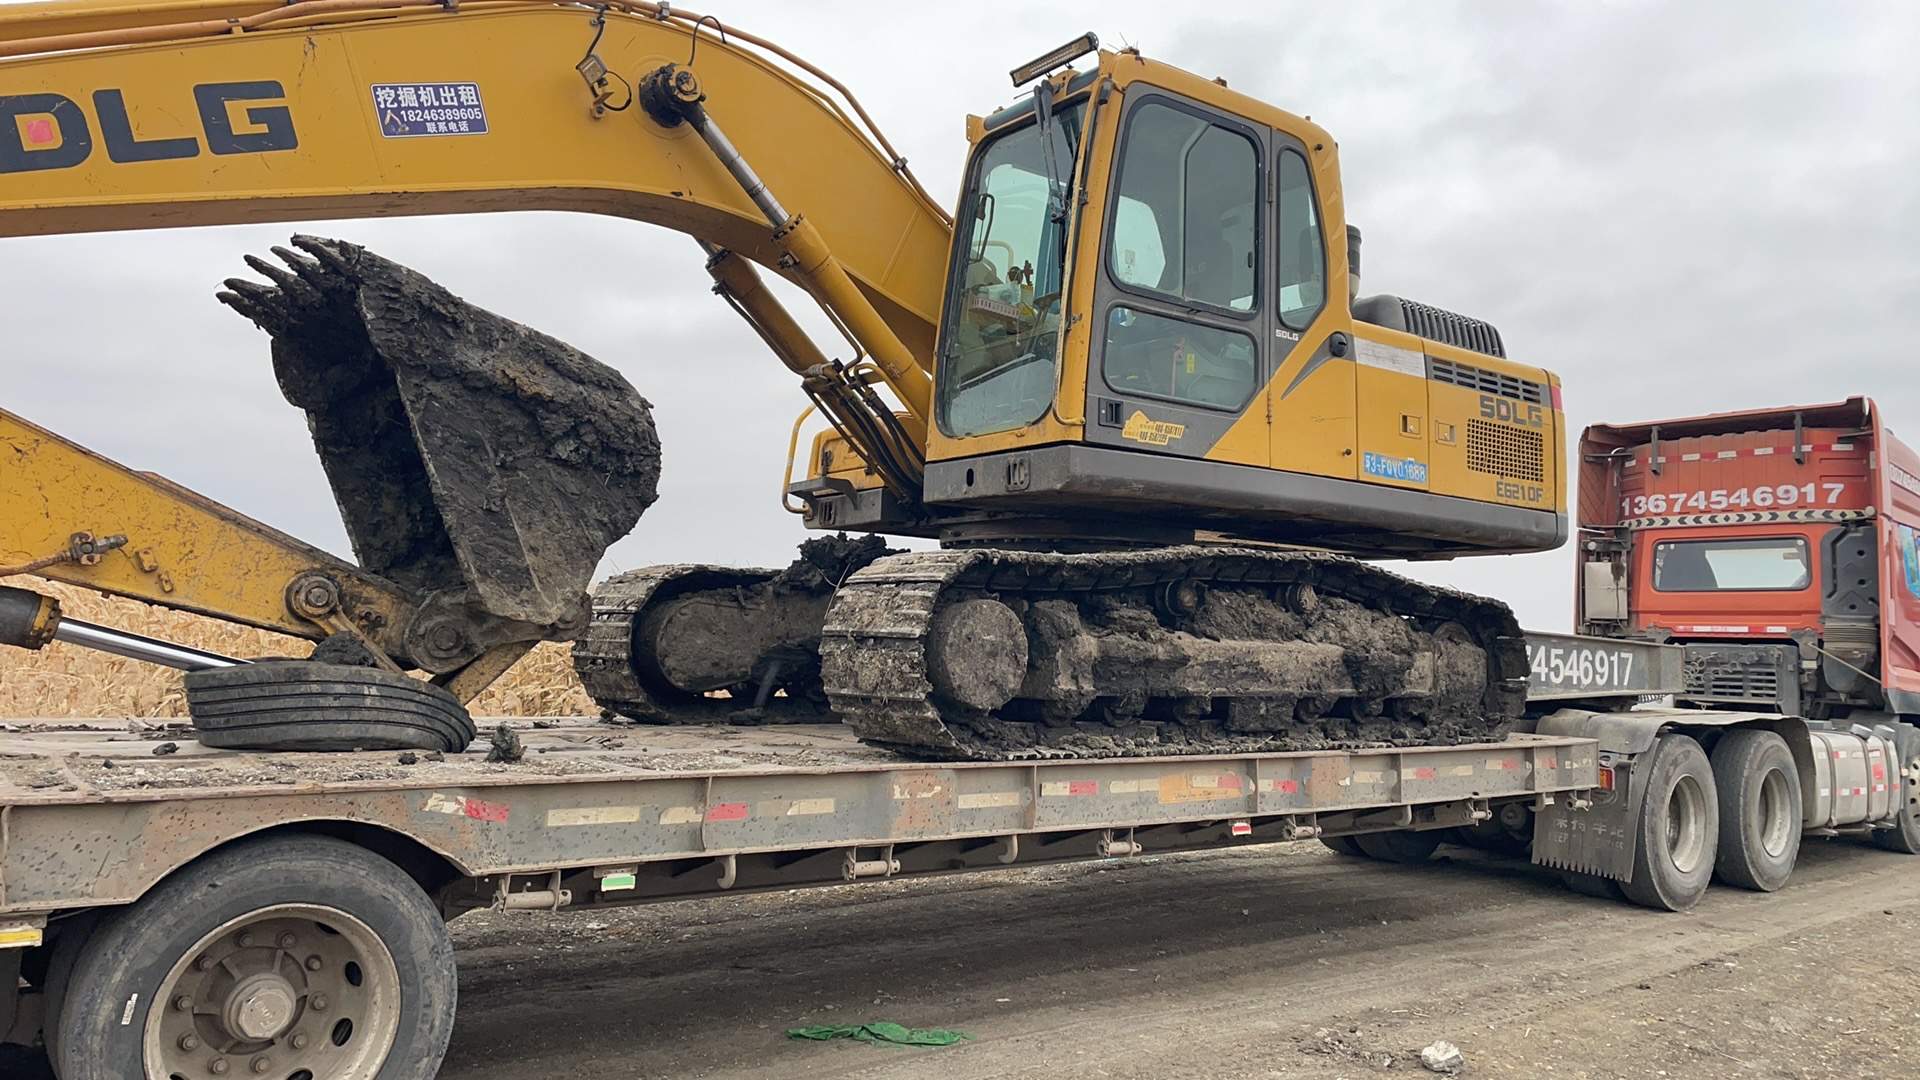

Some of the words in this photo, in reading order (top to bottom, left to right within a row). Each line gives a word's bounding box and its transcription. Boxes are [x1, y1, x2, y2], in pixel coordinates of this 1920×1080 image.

[376, 86, 479, 108] 挖掘机出租
[400, 108, 482, 122] 18246389605
[426, 121, 469, 133] 联系电话
[1275, 329, 1299, 341] SDLG
[1479, 395, 1542, 428] SDLG
[1496, 480, 1543, 502] E6210F
[1622, 483, 1844, 516] 13674546917
